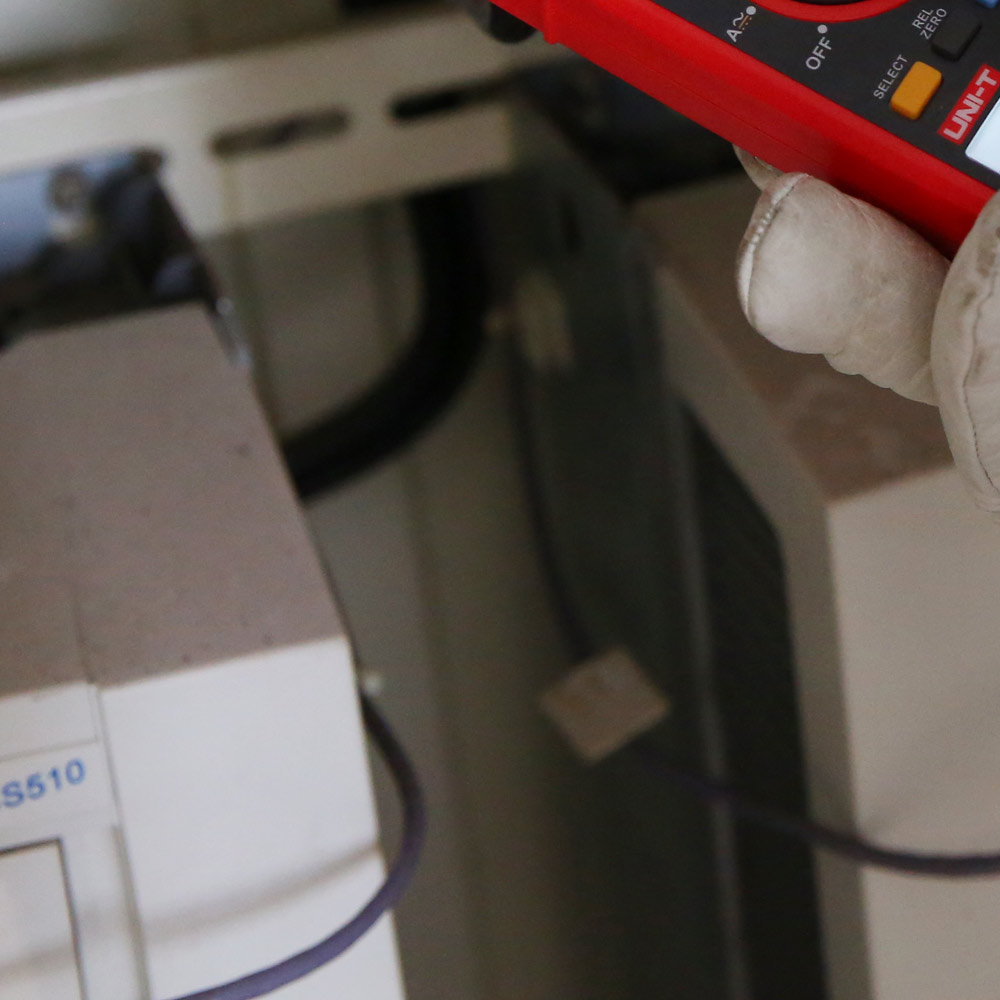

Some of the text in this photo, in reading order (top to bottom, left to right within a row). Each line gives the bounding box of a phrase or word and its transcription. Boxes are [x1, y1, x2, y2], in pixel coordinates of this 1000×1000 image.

[912, 8, 934, 30] REL
[920, 8, 948, 40] ZERO
[805, 36, 832, 70] OFF
[873, 53, 908, 100] SELECT
[943, 68, 998, 141] UNI-T
